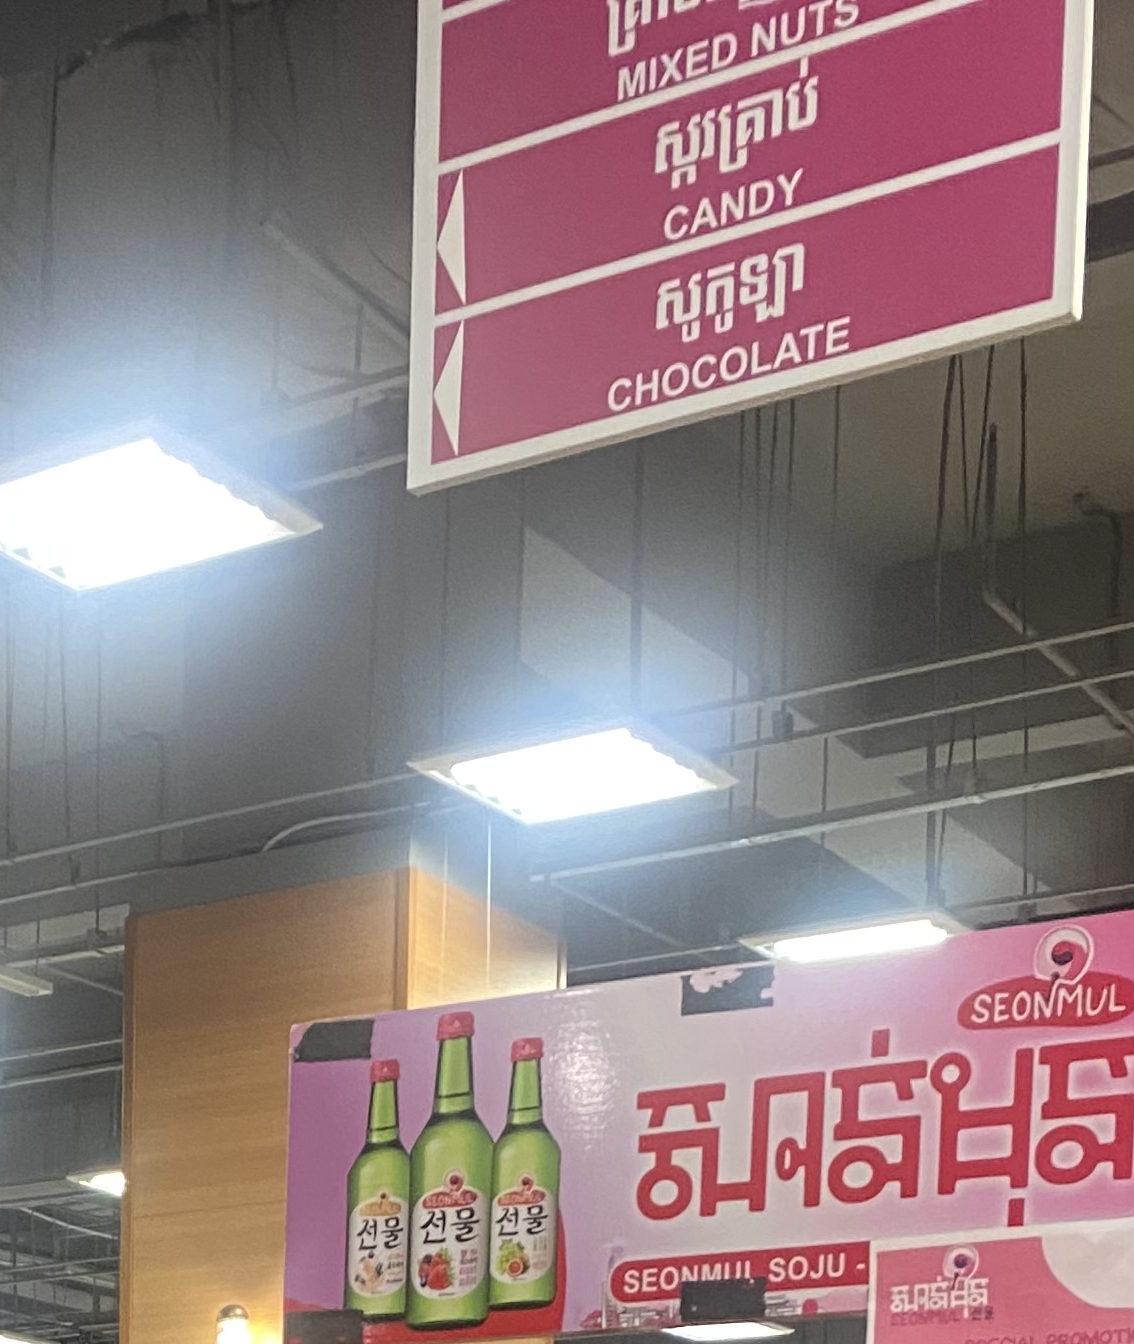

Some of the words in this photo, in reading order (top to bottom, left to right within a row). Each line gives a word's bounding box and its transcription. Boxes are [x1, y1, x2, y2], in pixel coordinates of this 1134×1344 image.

[618, 32, 738, 101] MIXED
[751, 0, 860, 57] NUTS
[664, 169, 803, 242] CANDY
[656, 243, 805, 343] សូកូឡា
[607, 317, 851, 414] CHOCOLATE
[971, 983, 1127, 1026] SEONMUL
[420, 1207, 481, 1245] 선물
[495, 1204, 549, 1237] 선물
[768, 1252, 846, 1283] SOJU
